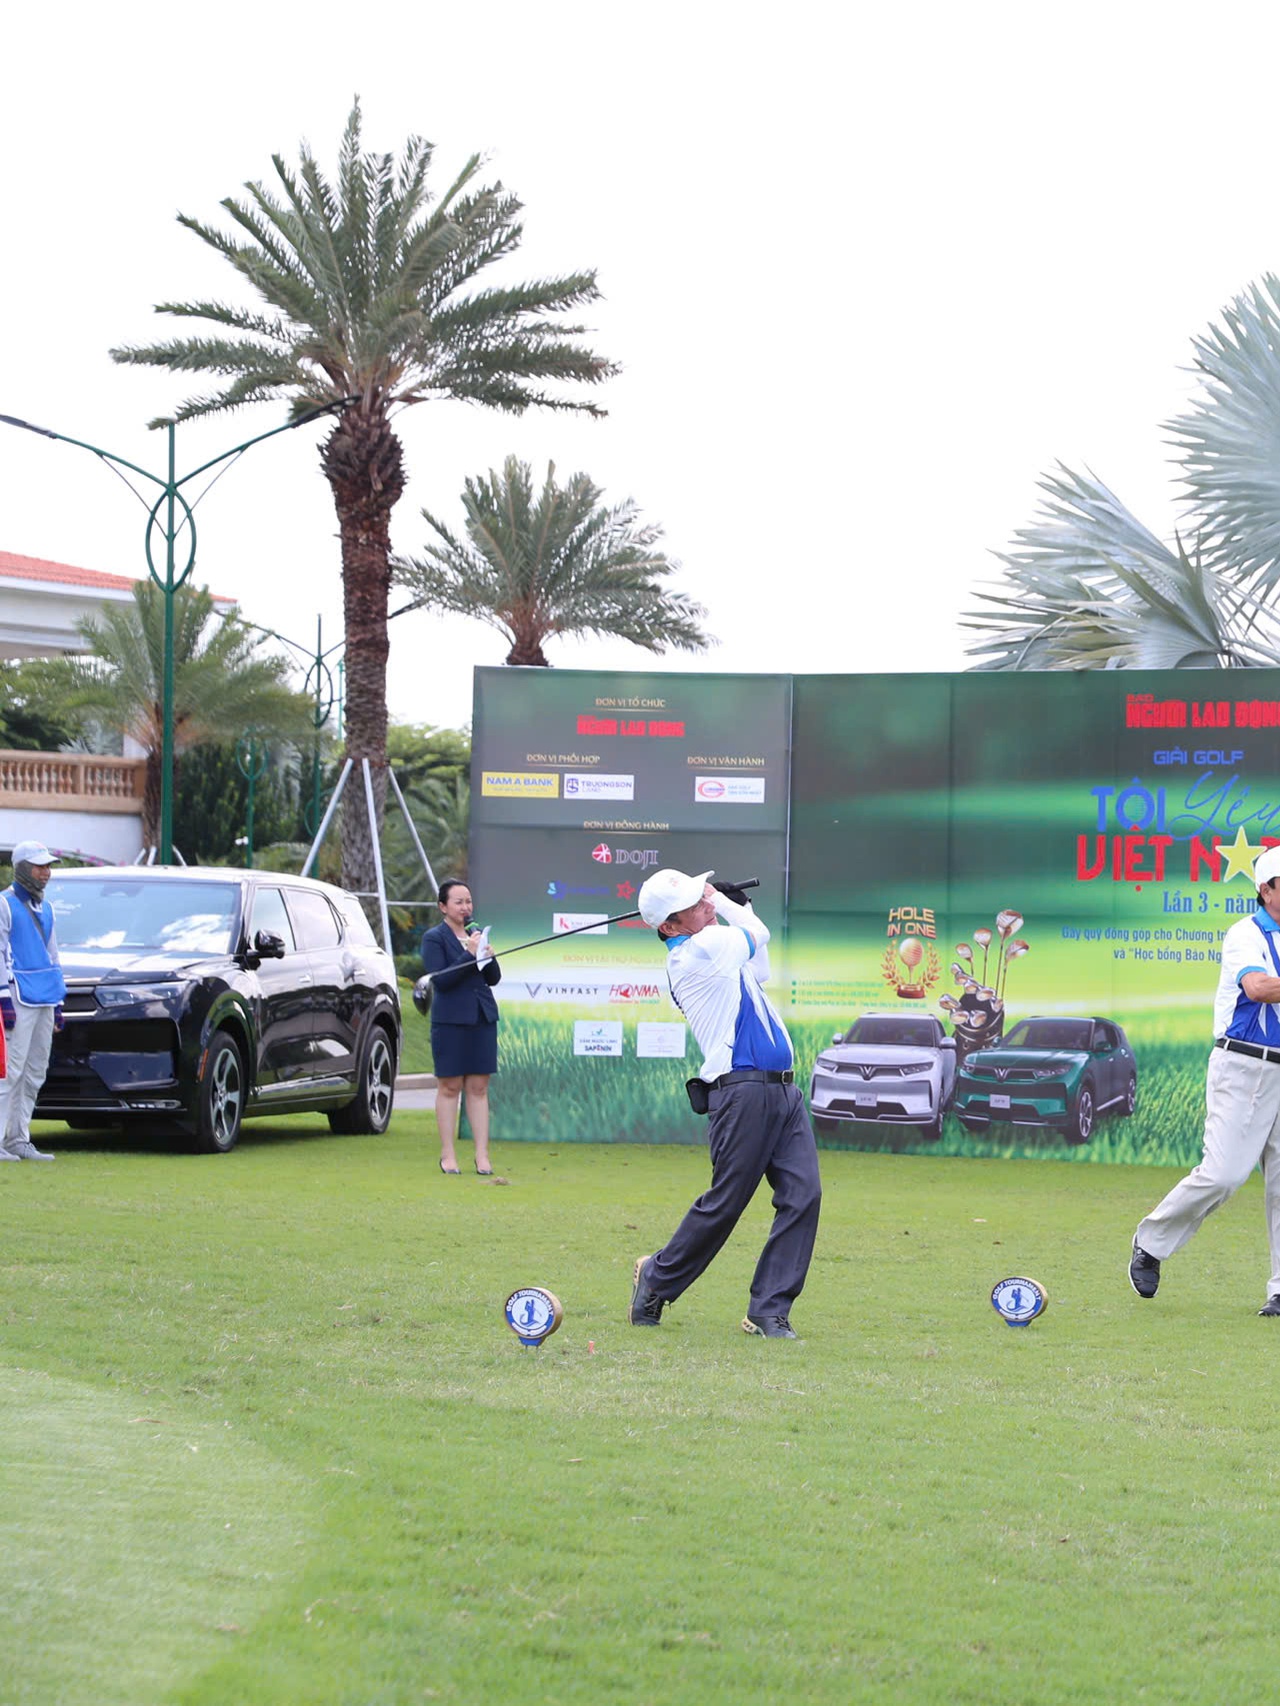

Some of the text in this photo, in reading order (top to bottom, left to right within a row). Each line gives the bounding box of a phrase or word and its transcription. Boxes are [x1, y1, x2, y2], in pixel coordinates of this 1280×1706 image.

[1193, 750, 1245, 765] GOLF
[486, 776, 512, 786] NAM
[523, 777, 554, 787] BANK
[1091, 776, 1166, 833] TÔI
[615, 848, 659, 870] DOJI
[1077, 825, 1174, 892] VIỆT
[1162, 890, 1193, 913] Lần
[1198, 891, 1209, 914] 3
[888, 906, 936, 923] HOLE
[887, 922, 937, 940] IN ONE
[1154, 928, 1172, 940] cho
[546, 986, 599, 995] VINFAST
